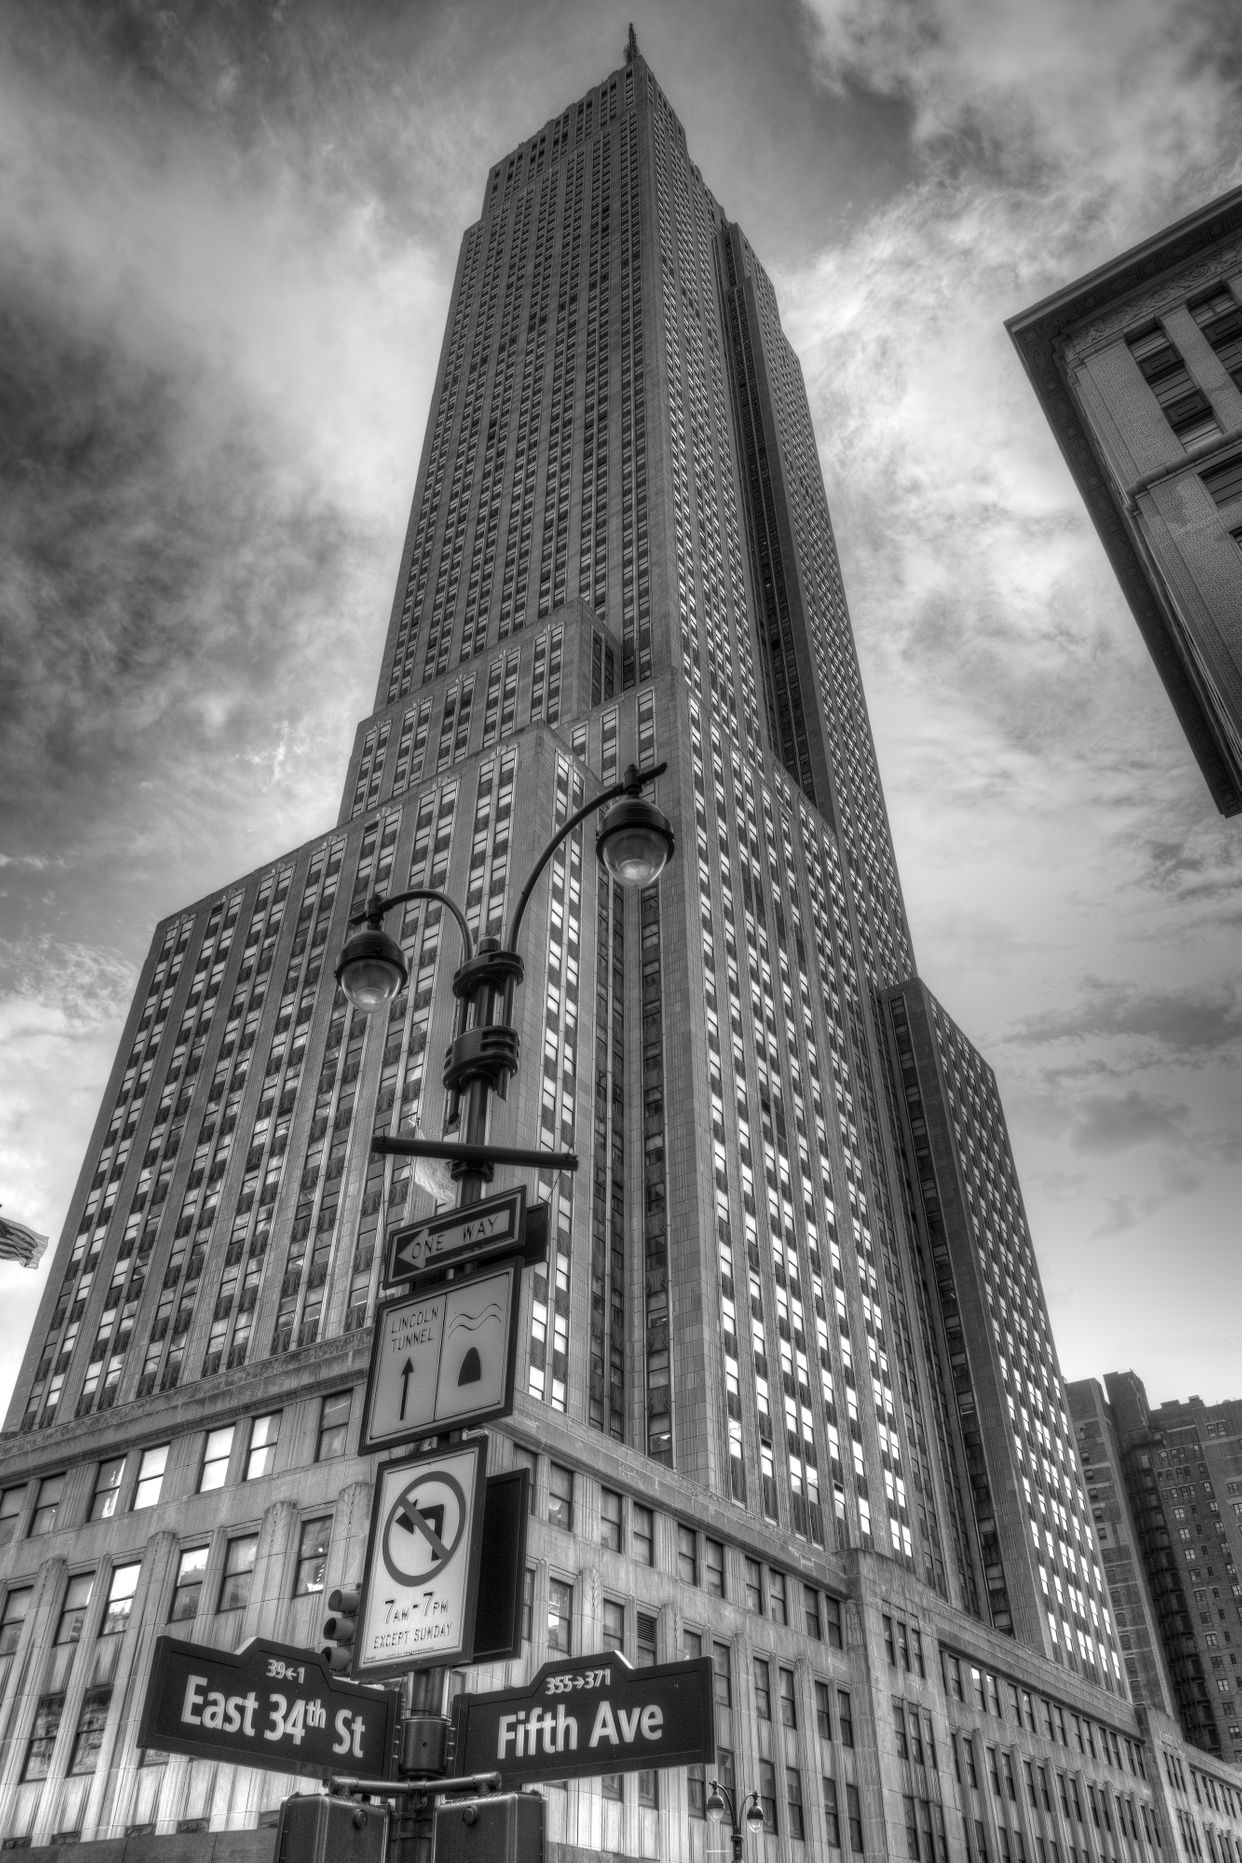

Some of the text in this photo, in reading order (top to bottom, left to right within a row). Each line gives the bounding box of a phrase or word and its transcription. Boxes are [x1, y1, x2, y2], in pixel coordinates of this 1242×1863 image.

[411, 1234, 444, 1259] ONE
[463, 1216, 498, 1241] WAY
[391, 1306, 439, 1333] LINCOLN
[391, 1327, 433, 1352] TUNNEL
[373, 1622, 453, 1649] EXCEPT SUNDAY
[180, 1674, 366, 1758] East 34th St
[497, 1700, 664, 1759] Fifth Ave
